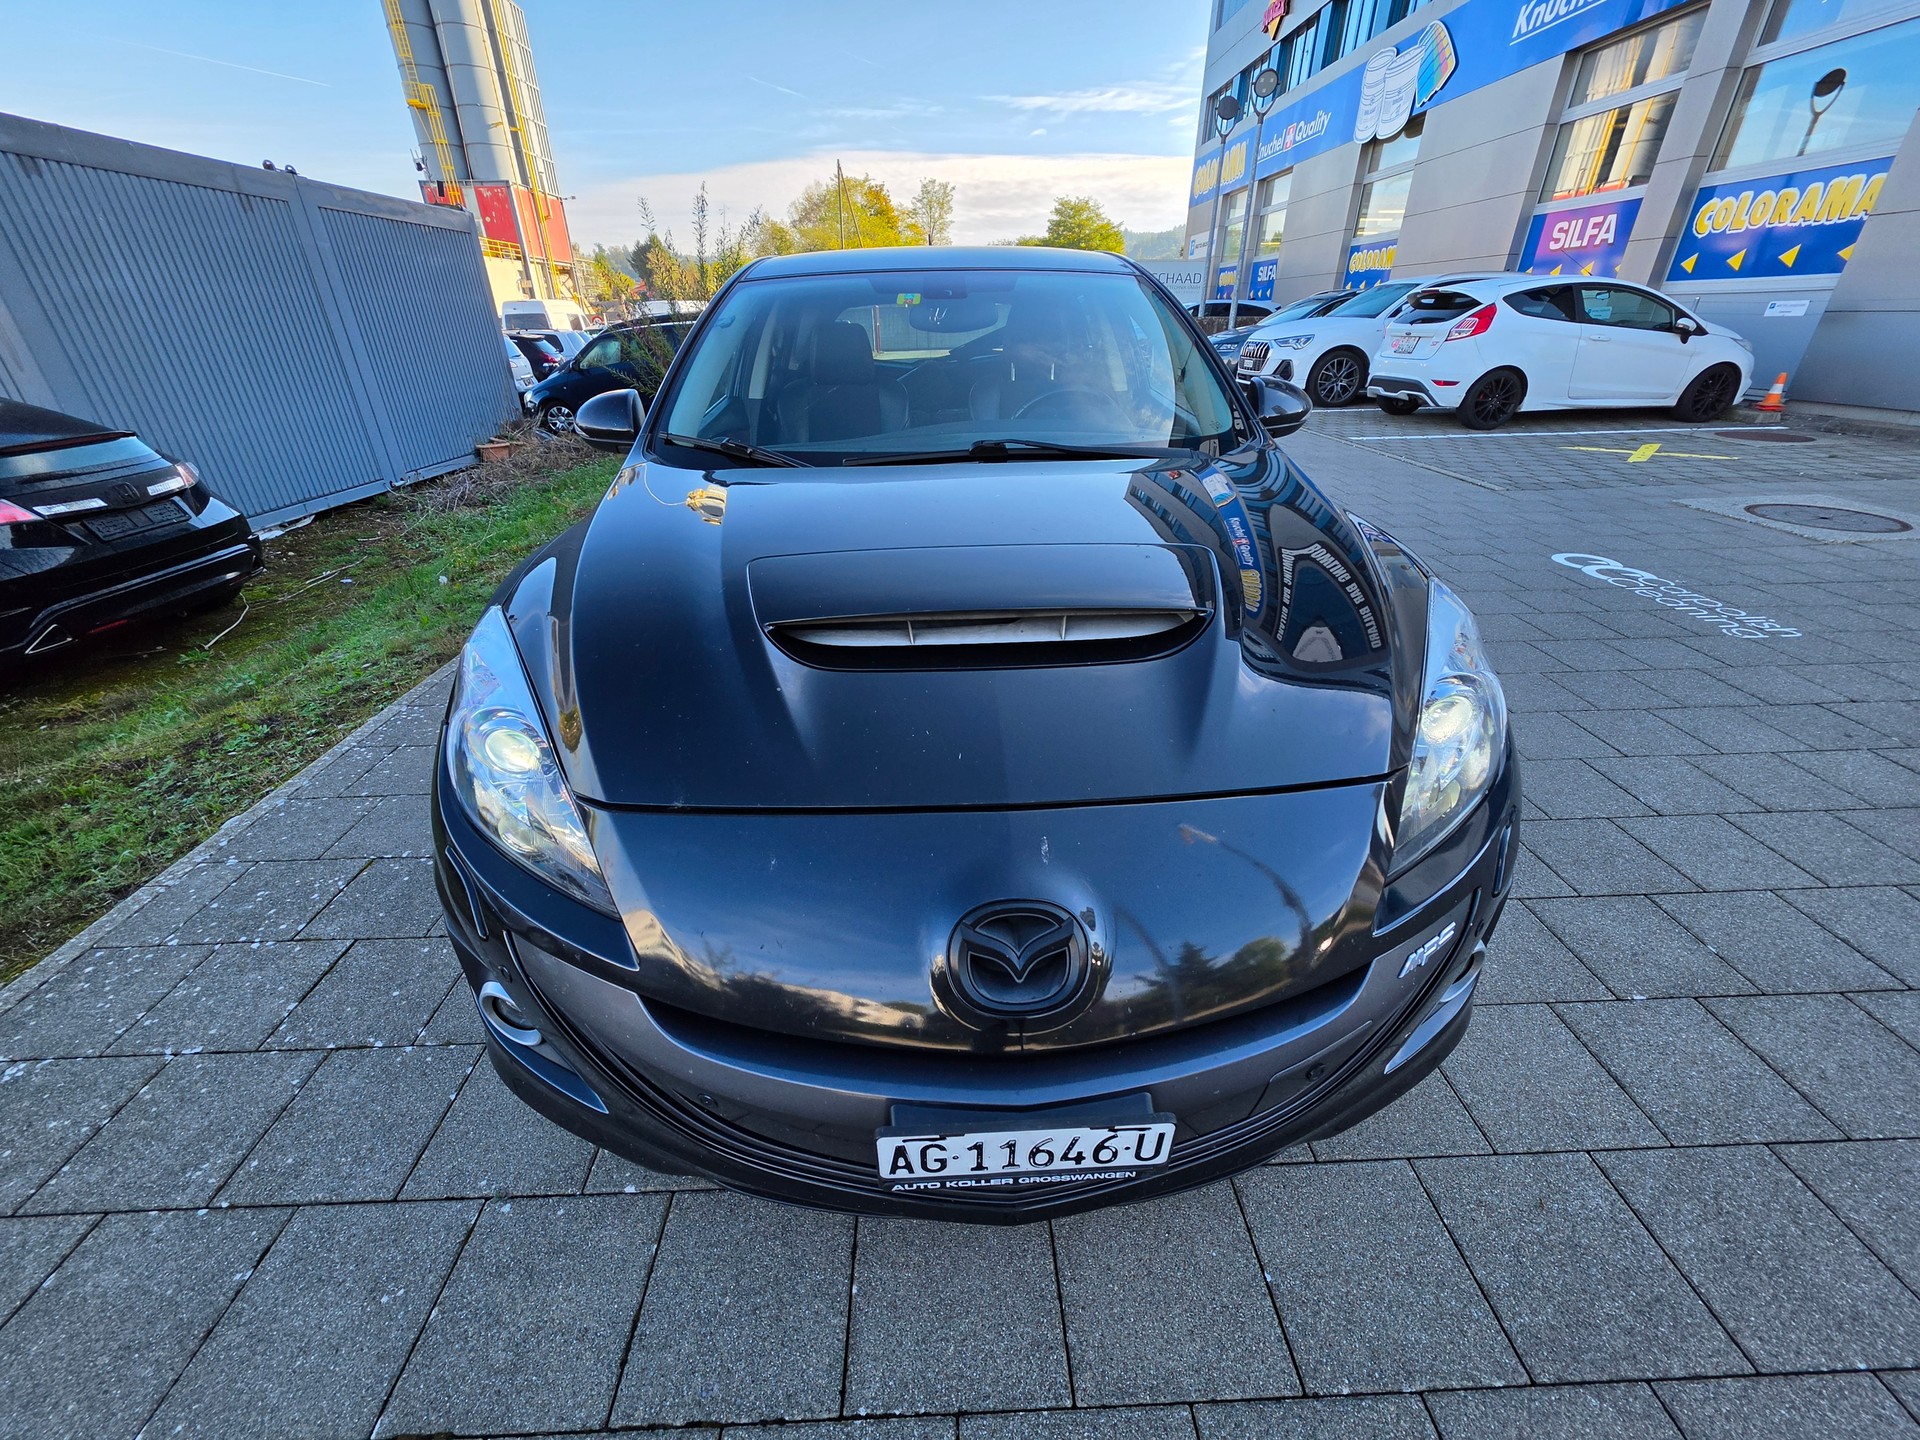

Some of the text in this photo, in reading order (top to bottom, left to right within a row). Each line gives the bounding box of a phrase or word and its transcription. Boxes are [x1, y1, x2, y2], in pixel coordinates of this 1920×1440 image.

[1512, 0, 1592, 38] Knuc
[1295, 110, 1332, 142] Quality
[1193, 141, 1248, 199] COLOAMA
[1693, 173, 1888, 238] COLORAMA
[1549, 213, 1618, 250] SILFA
[1257, 264, 1277, 281] SILFA
[1349, 245, 1397, 274] COLORAM
[1153, 272, 1202, 284] CHAAD
[1281, 548, 1296, 586] BOWLING
[1283, 586, 1291, 605] BAR
[891, 1171, 1137, 1192] AUTO KOLLER GROSSWANGEN
